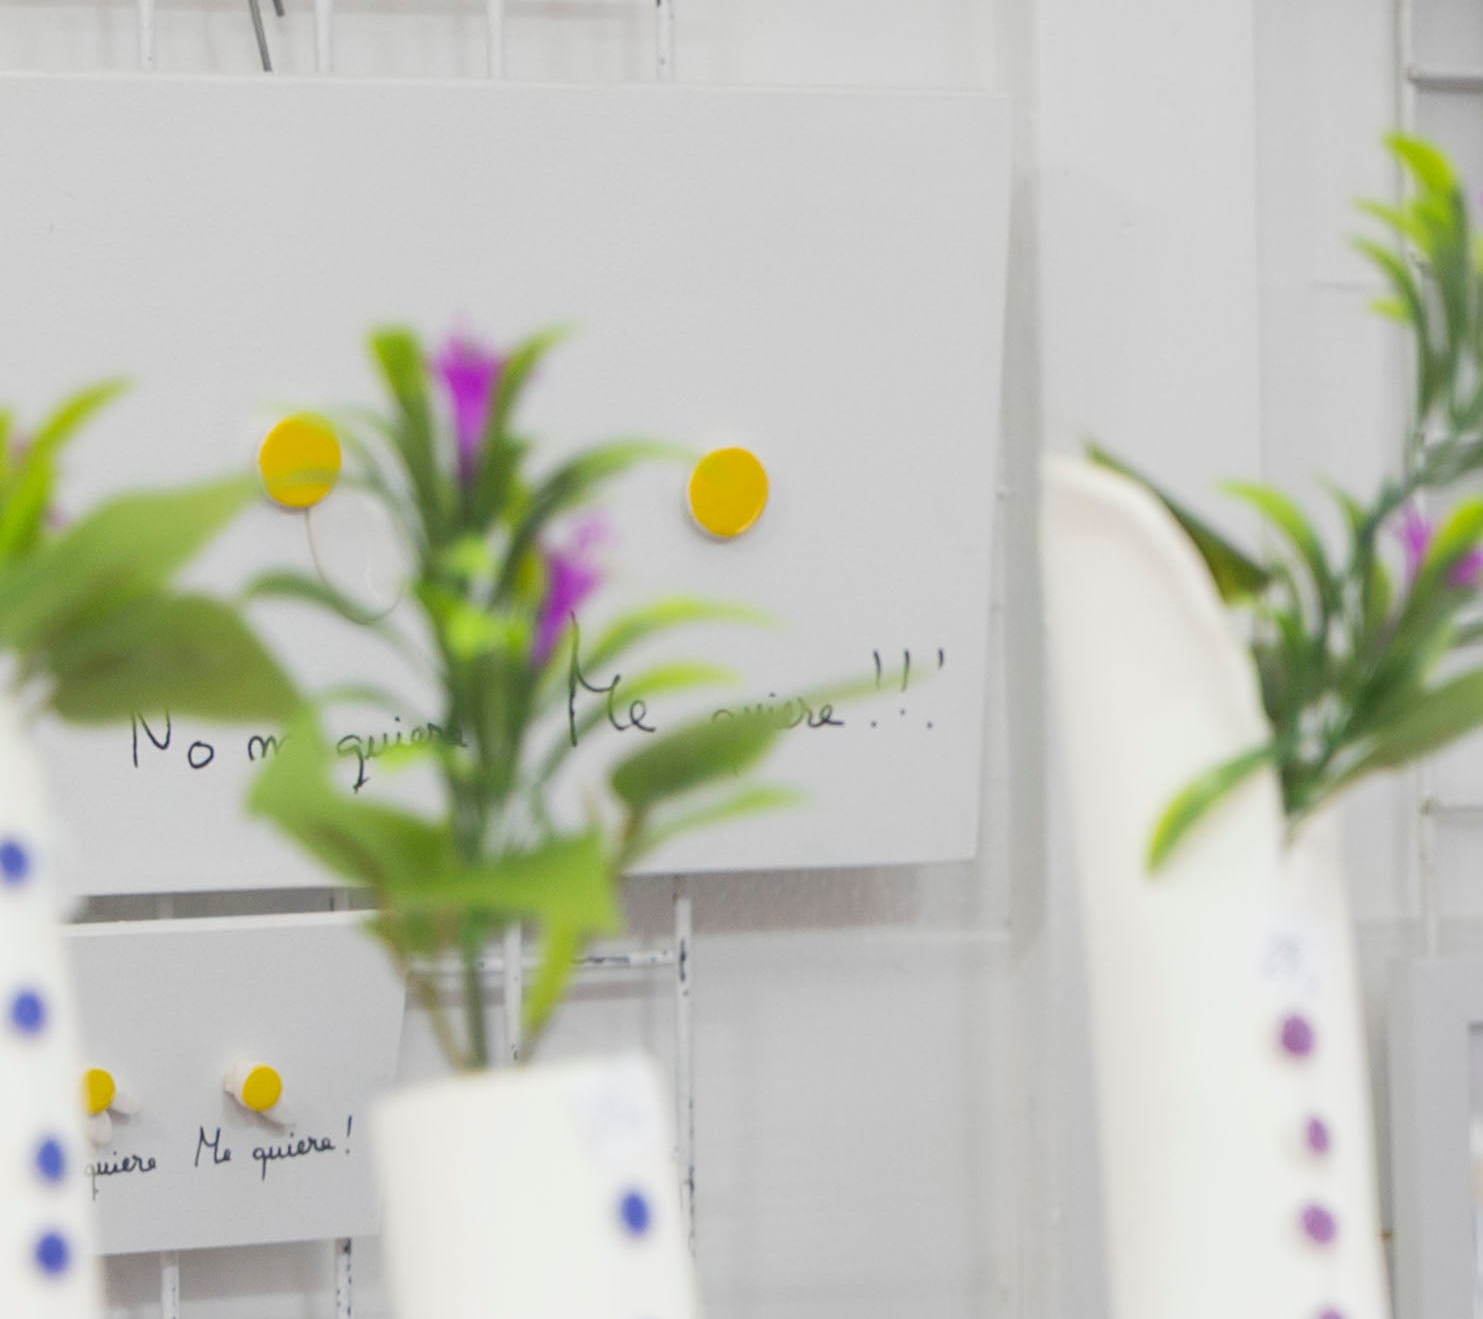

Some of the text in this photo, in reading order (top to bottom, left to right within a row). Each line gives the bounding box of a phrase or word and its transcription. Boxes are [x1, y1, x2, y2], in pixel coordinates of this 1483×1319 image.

[569, 611, 656, 747] Me
[131, 710, 214, 769] No
[248, 734, 290, 761] m
[194, 1125, 231, 1167] Me
